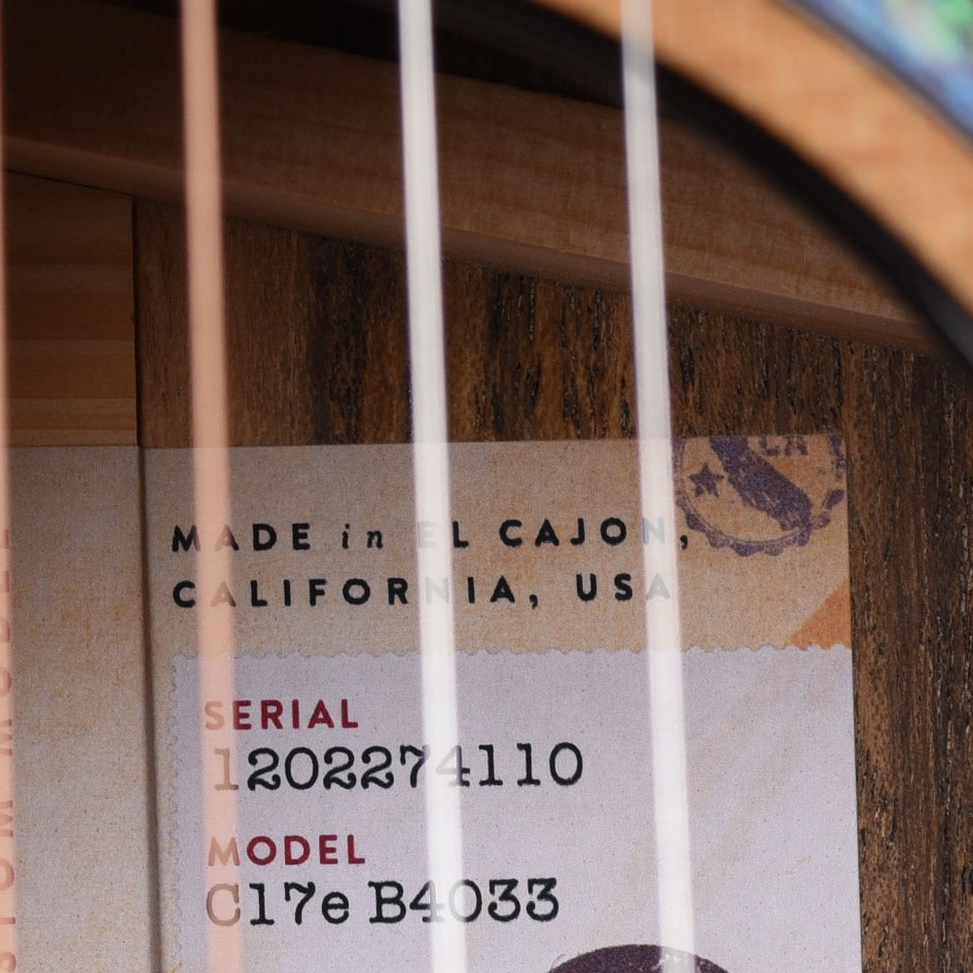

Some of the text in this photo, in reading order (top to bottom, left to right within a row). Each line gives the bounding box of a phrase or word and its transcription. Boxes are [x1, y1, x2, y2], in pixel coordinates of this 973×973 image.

[171, 516, 688, 552] MADE in EL CAJON,
[172, 571, 671, 610] CALIFORNIA, USA
[204, 698, 360, 731] SERIAL
[213, 741, 584, 792] 1202274110
[207, 834, 366, 867] MODEL
[205, 877, 561, 927] C17e B4033
